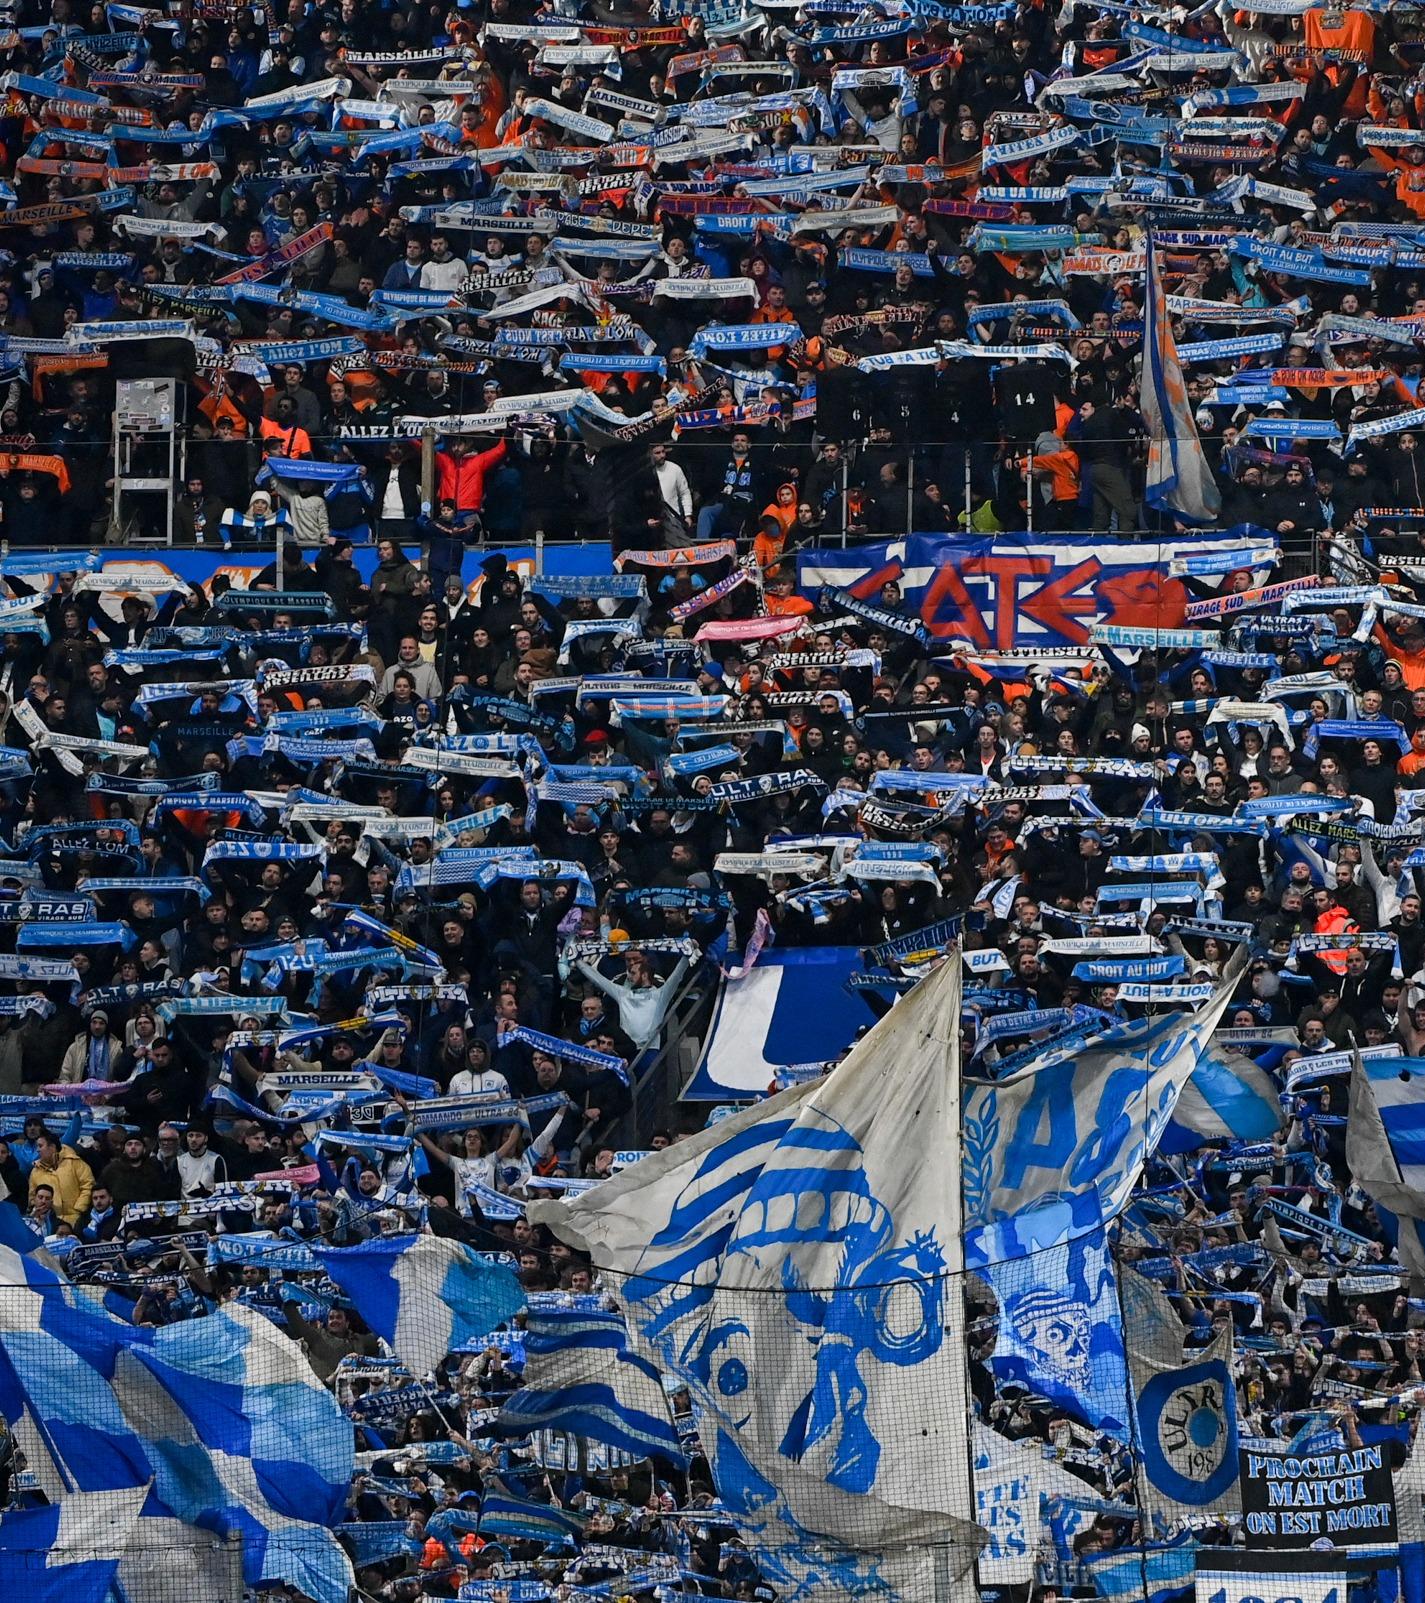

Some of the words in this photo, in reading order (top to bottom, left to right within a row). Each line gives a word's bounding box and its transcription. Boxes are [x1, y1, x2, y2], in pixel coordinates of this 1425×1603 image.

[834, 26, 866, 38] ALLEZ
[346, 48, 443, 62] MARSEILLE
[590, 89, 657, 114] MARSEILLE
[1121, 194, 1202, 208] MARSEILLE
[461, 217, 534, 229] MARSEILLE
[718, 217, 747, 227] DROIT
[1252, 244, 1277, 256] DROIT
[1280, 250, 1293, 261] AU
[1295, 254, 1313, 263] BUT
[1341, 246, 1389, 259] GROUPE
[383, 291, 418, 303] OLYMPIQUE
[268, 343, 303, 358] Allez
[1220, 340, 1270, 355] MARSEILLE
[341, 424, 388, 439] ALLEZ
[1225, 596, 1244, 612] SUD
[1106, 628, 1204, 648] MARSEILLE
[53, 838, 90, 852] ALLEZ
[96, 839, 128, 853] L'OM
[39, 904, 84, 916] RAS
[1089, 965, 1124, 978] DROIT
[1126, 964, 1142, 977] AU
[1146, 962, 1168, 976] BUT
[278, 1074, 360, 1085] MARSEILLE
[1248, 1446, 1383, 1479] PROCHAIN
[1268, 1476, 1367, 1505] MATCH
[1247, 1513, 1275, 1535] ON
[1285, 1511, 1322, 1533] EST
[1326, 1504, 1391, 1529] MORT
